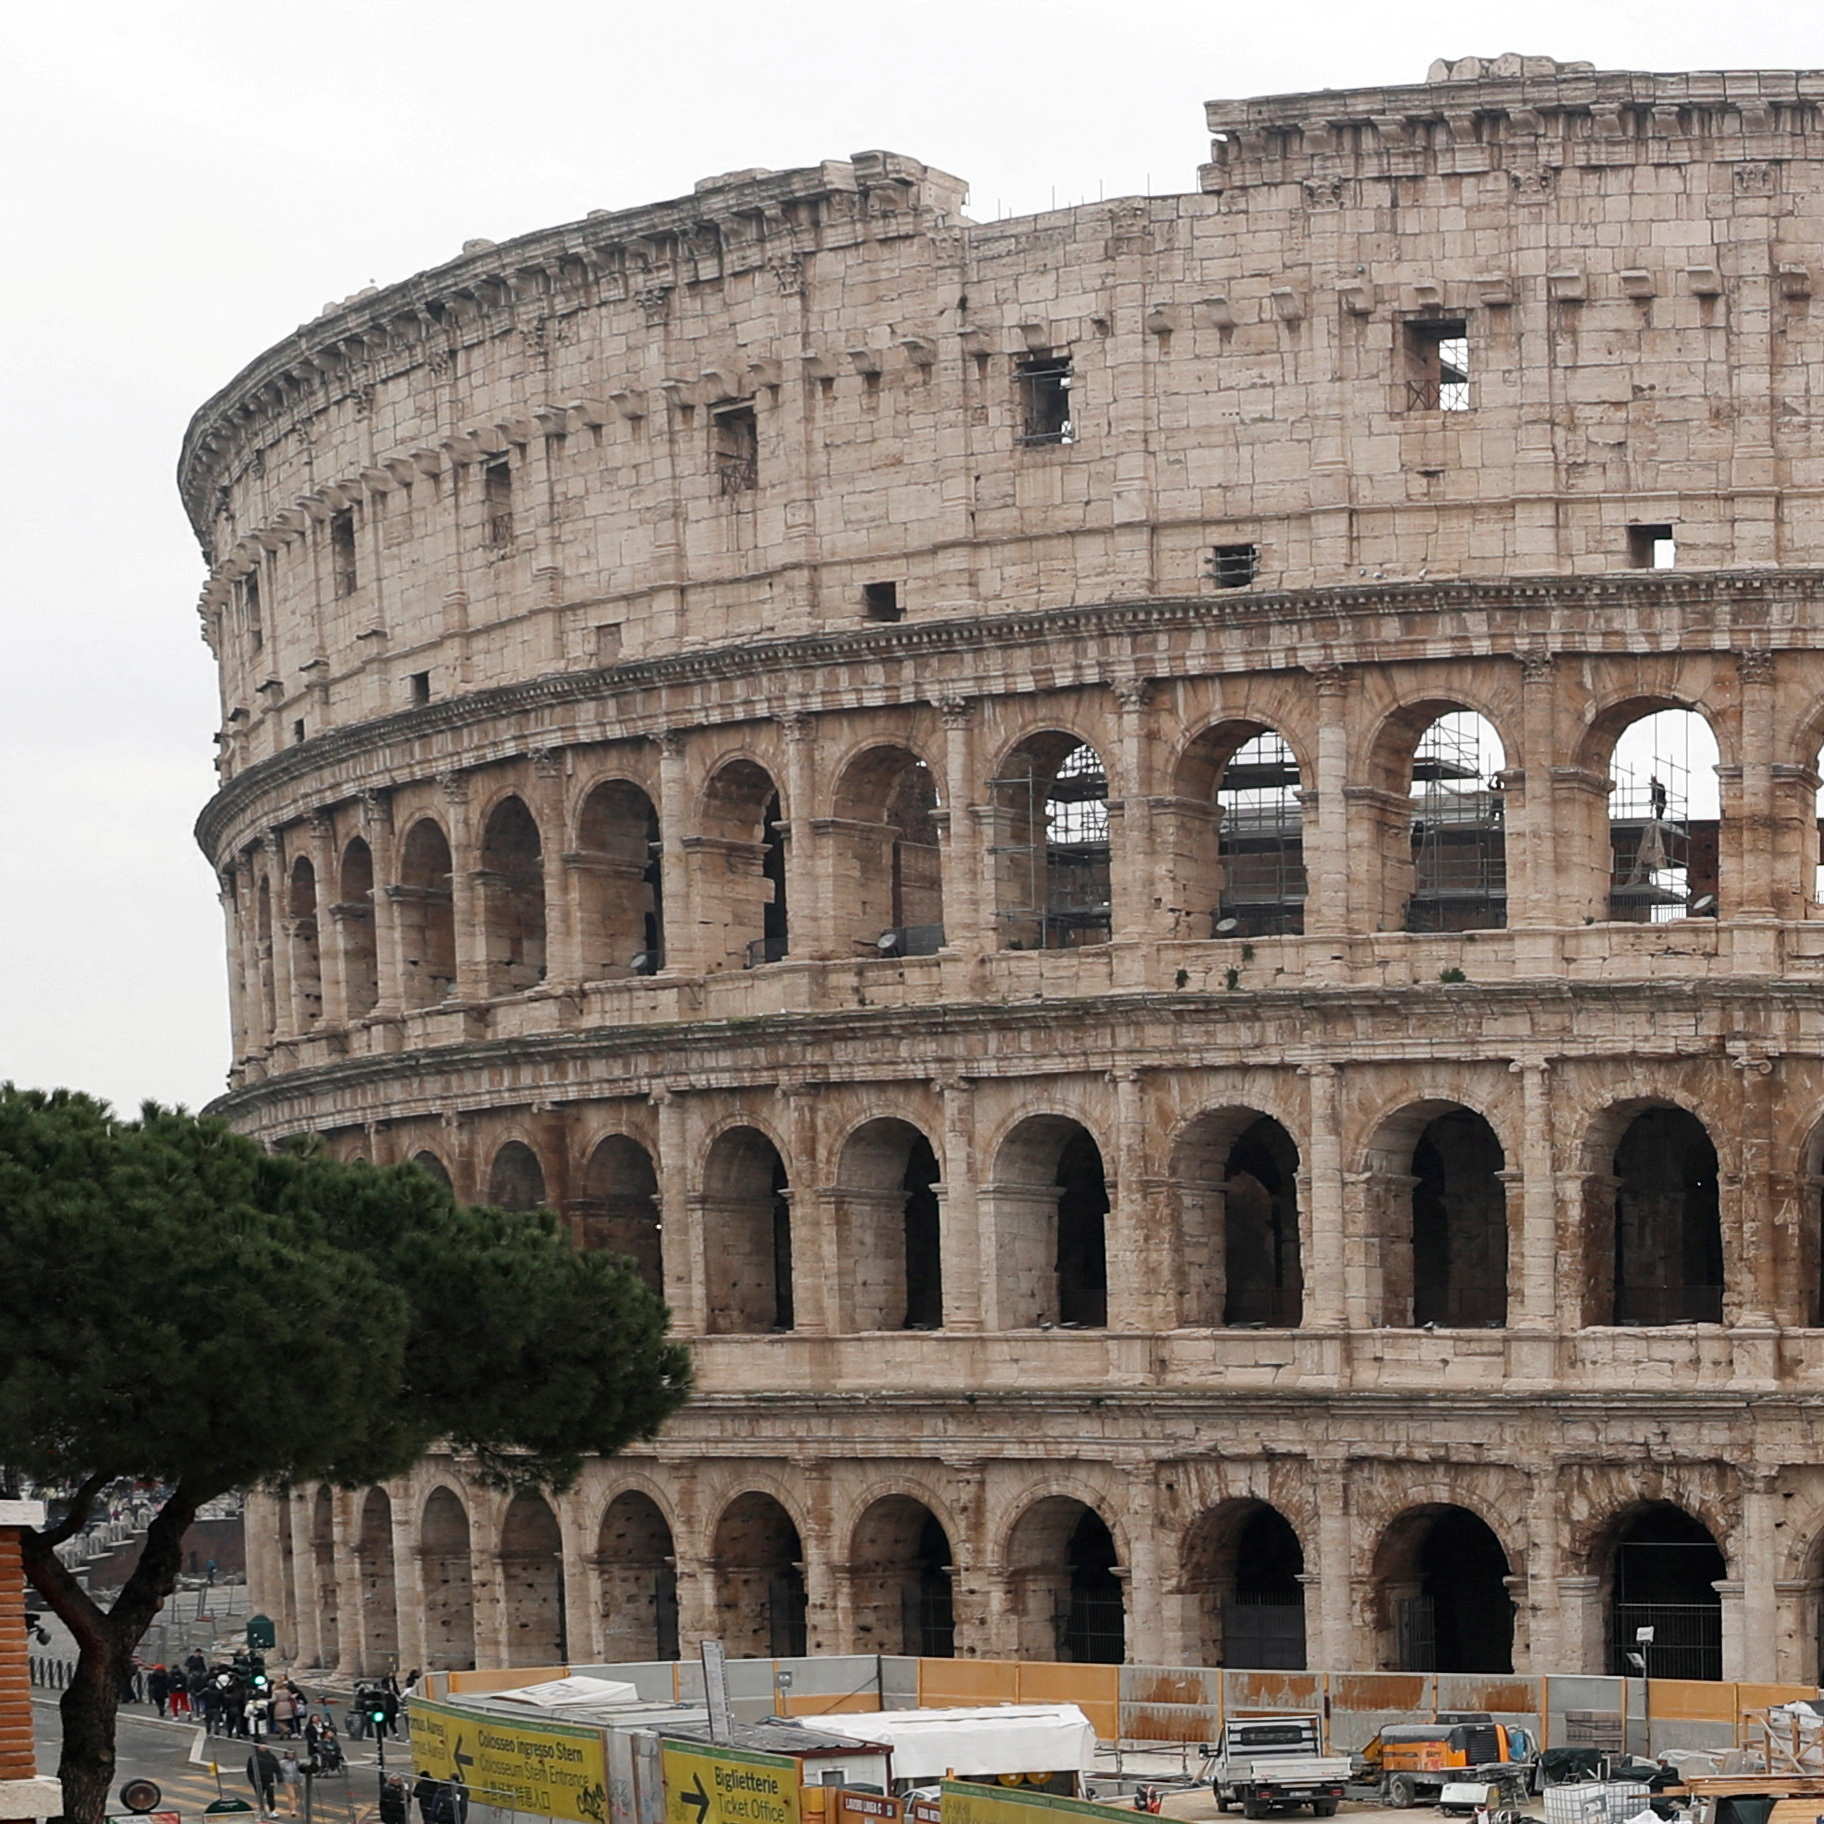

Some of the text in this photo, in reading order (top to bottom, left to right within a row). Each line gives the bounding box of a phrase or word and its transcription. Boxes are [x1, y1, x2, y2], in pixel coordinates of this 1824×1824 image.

[478, 1729, 582, 1762] Colosseo ingresso Stern
[480, 1756, 523, 1777] Colosseum
[550, 1766, 589, 1787] Entrance
[714, 1766, 778, 1795] Biglietterie
[716, 1793, 785, 1823] Ticket Office
